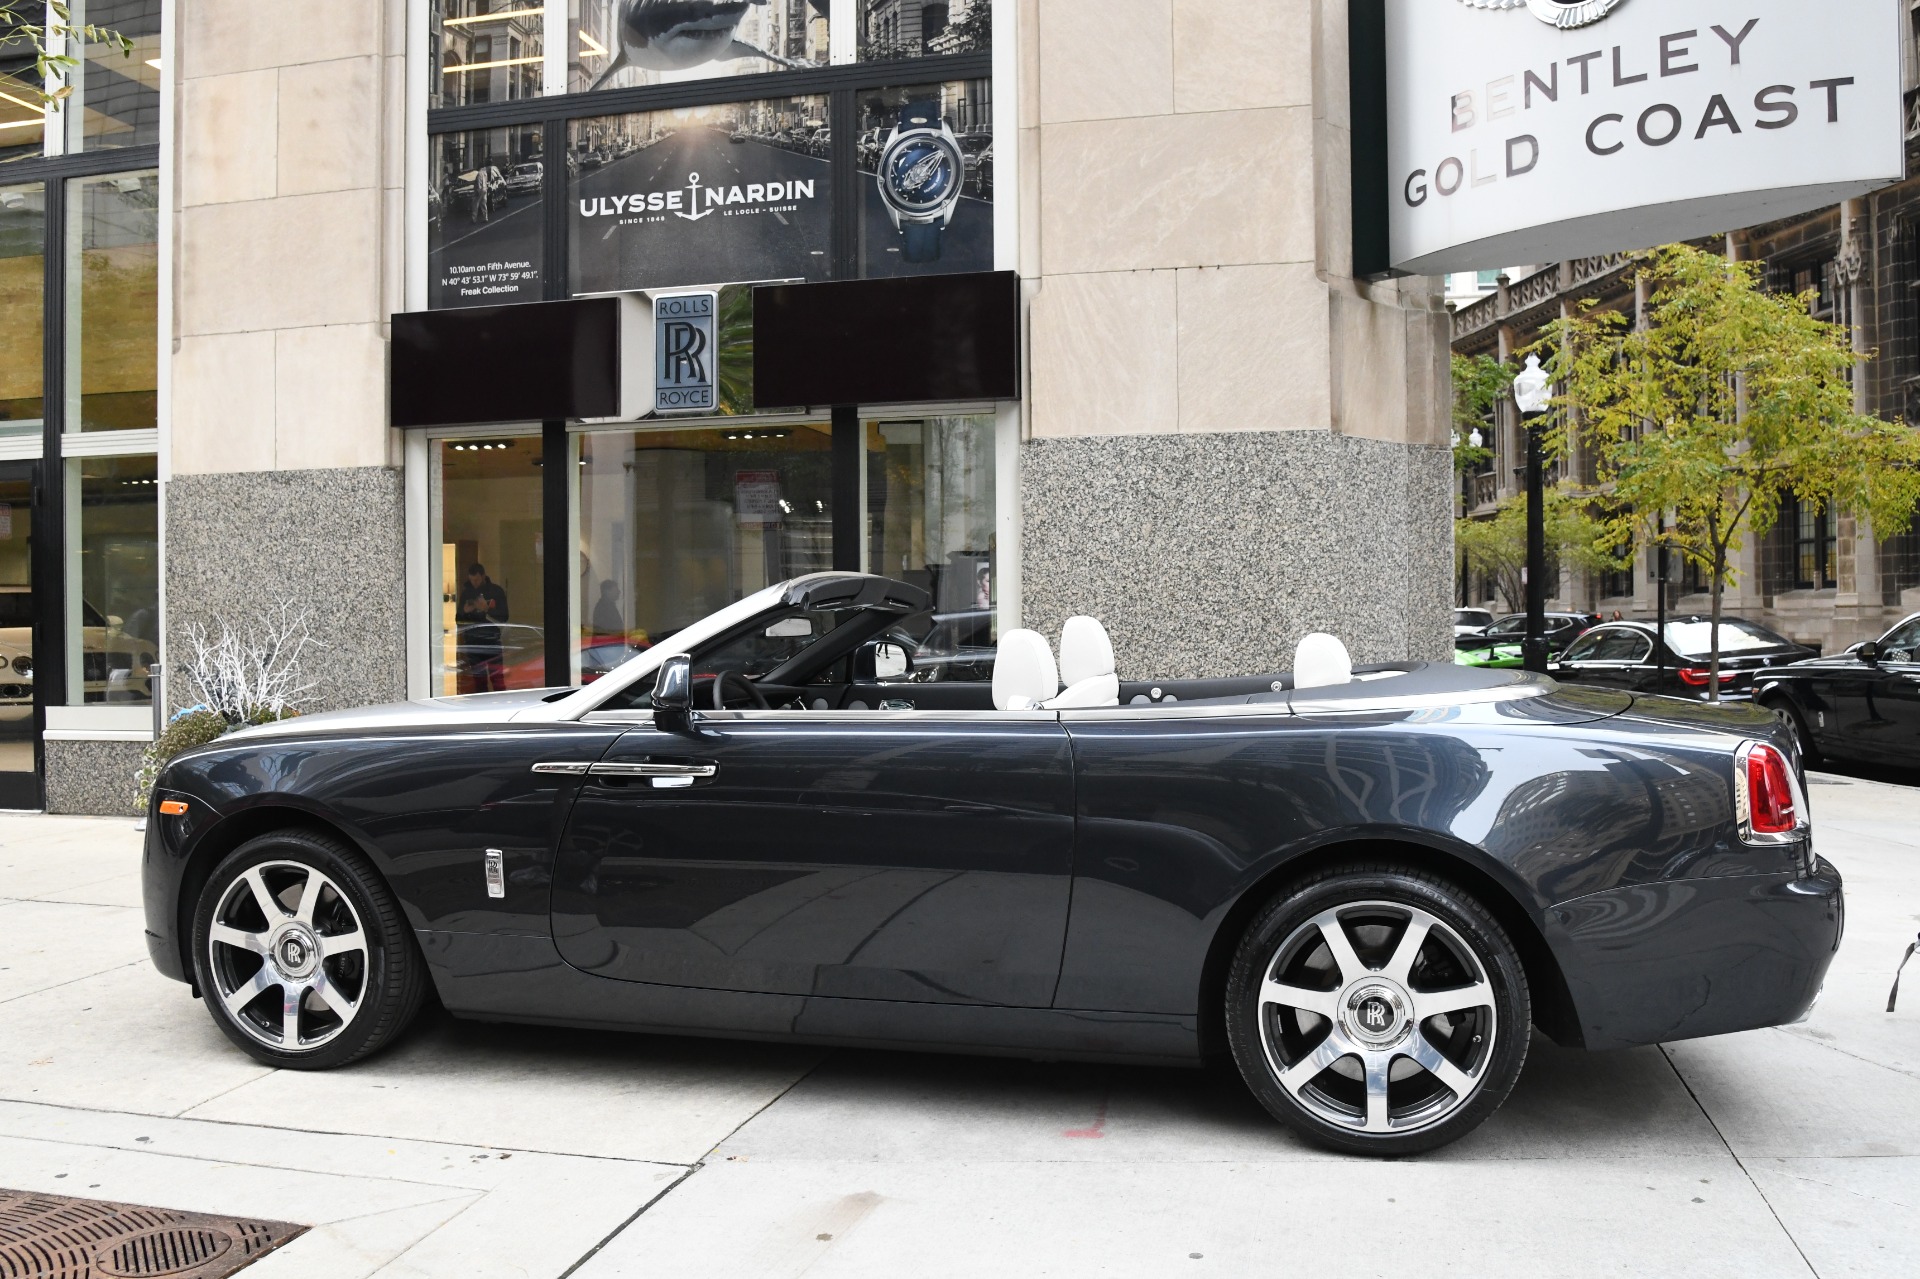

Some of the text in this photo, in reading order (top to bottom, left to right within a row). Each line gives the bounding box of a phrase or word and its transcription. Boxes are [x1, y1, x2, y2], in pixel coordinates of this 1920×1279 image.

[1451, 17, 1760, 134] BENTLEY
[1403, 76, 1855, 208] GOLD COAST
[579, 179, 815, 217] ULYSSE NARDIN
[769, 205, 798, 213] SUISSE
[619, 217, 643, 225] SINCE
[449, 265, 476, 274] 10.10am
[487, 262, 503, 271] Fifth
[504, 261, 531, 270] Avenue.
[441, 278, 448, 287] N
[489, 274, 497, 282] W
[460, 285, 519, 297] Freak Collection
[660, 300, 709, 315] ROLLS
[660, 390, 709, 405] ROYCE
